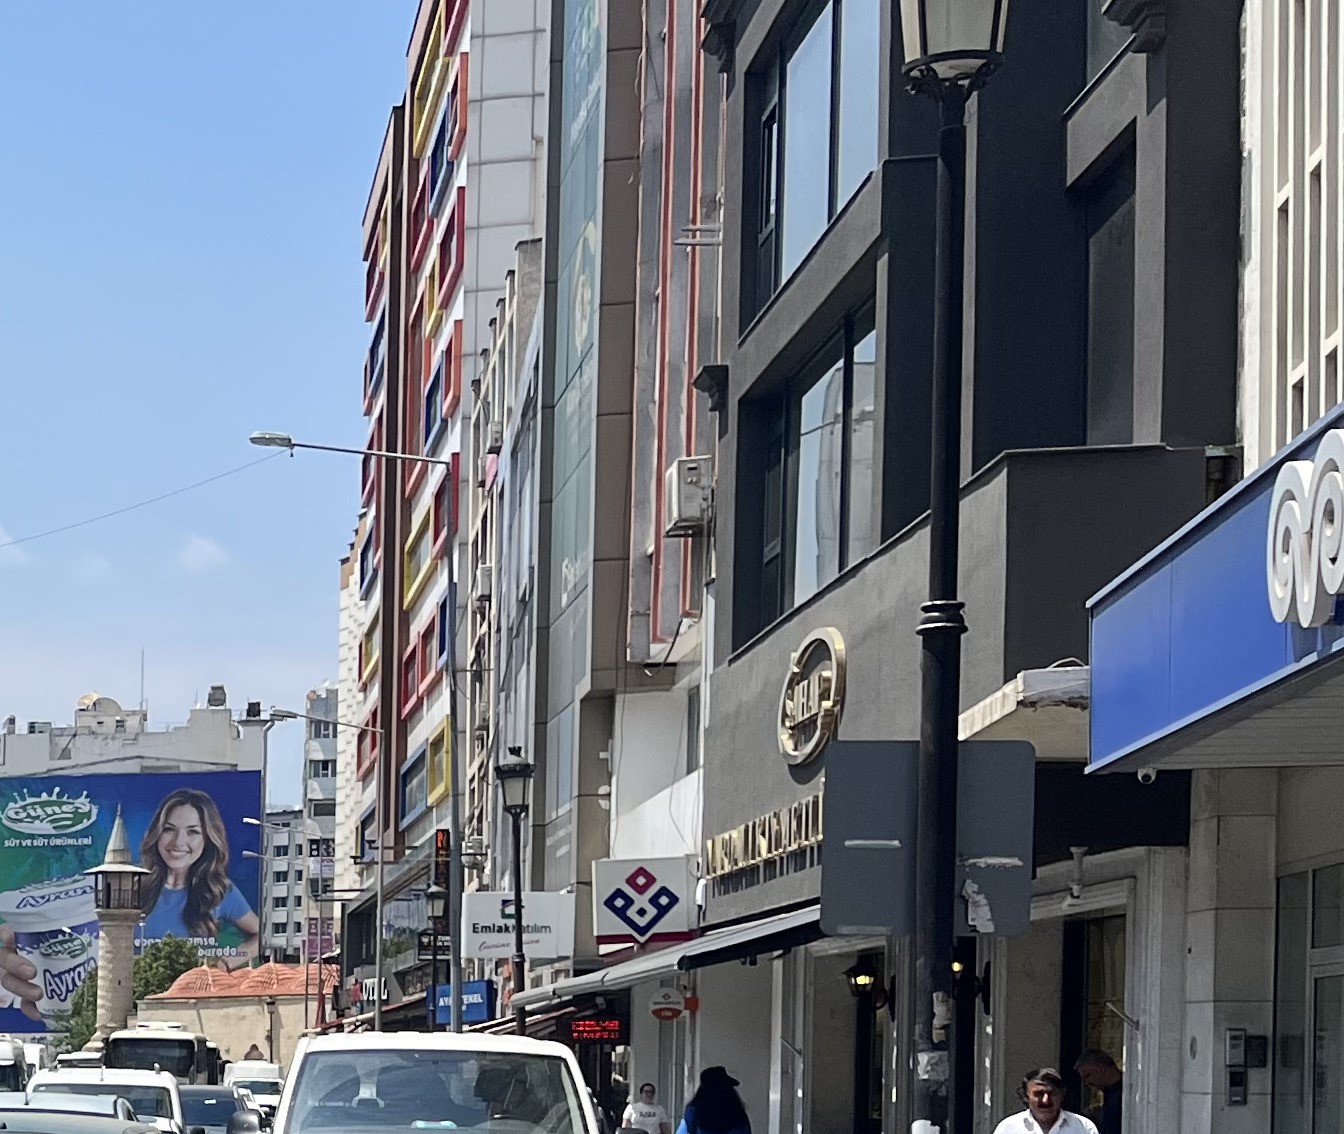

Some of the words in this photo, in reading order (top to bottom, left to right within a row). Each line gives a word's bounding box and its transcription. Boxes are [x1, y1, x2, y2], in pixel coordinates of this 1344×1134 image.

[3, 838, 20, 848] SÜT
[21, 838, 32, 847] VE
[33, 837, 48, 847] SÜT
[49, 836, 92, 847] ÜRÜNLERİ
[16, 885, 95, 909] Ayran
